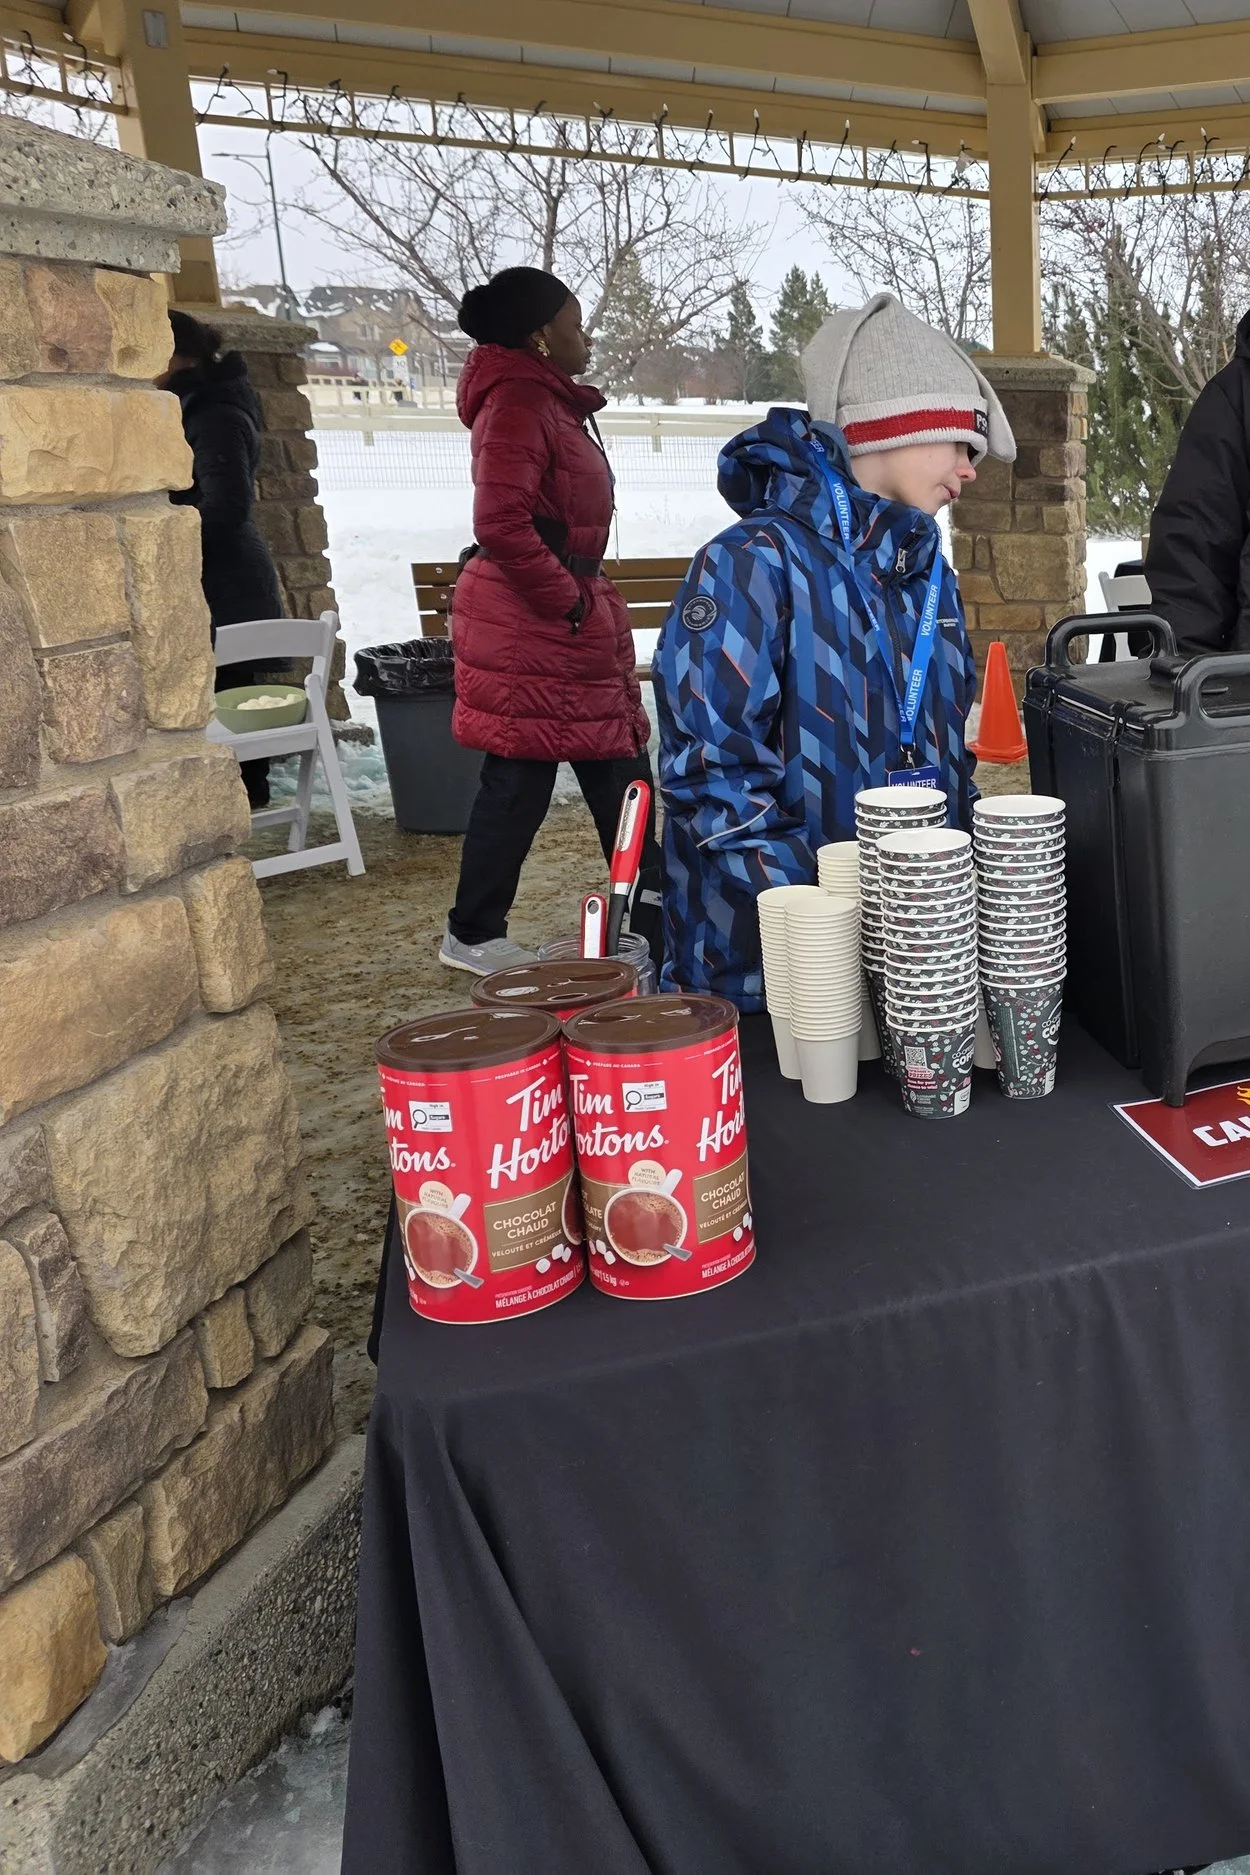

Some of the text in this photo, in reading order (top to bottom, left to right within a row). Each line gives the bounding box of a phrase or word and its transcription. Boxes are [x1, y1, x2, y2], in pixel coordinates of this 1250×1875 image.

[833, 482, 850, 540] VOLUNTEER
[921, 584, 939, 637] VOLUNTEER
[905, 669, 923, 721] VOLUNTEER
[506, 1076, 562, 1132] Tim
[569, 1074, 614, 1115] Tim
[388, 1136, 451, 1173] tons
[486, 1113, 571, 1190] Horto
[572, 1114, 665, 1157] ortons
[701, 1171, 746, 1202] CHOCOLAT
[712, 1188, 742, 1210] CHAUD
[493, 1201, 557, 1231] CHOCOLAT
[507, 1218, 549, 1239] CHAUD
[491, 1244, 525, 1258] VELOUTÉ
[524, 1241, 535, 1250] ET
[495, 1294, 528, 1309] MÉLANGE
